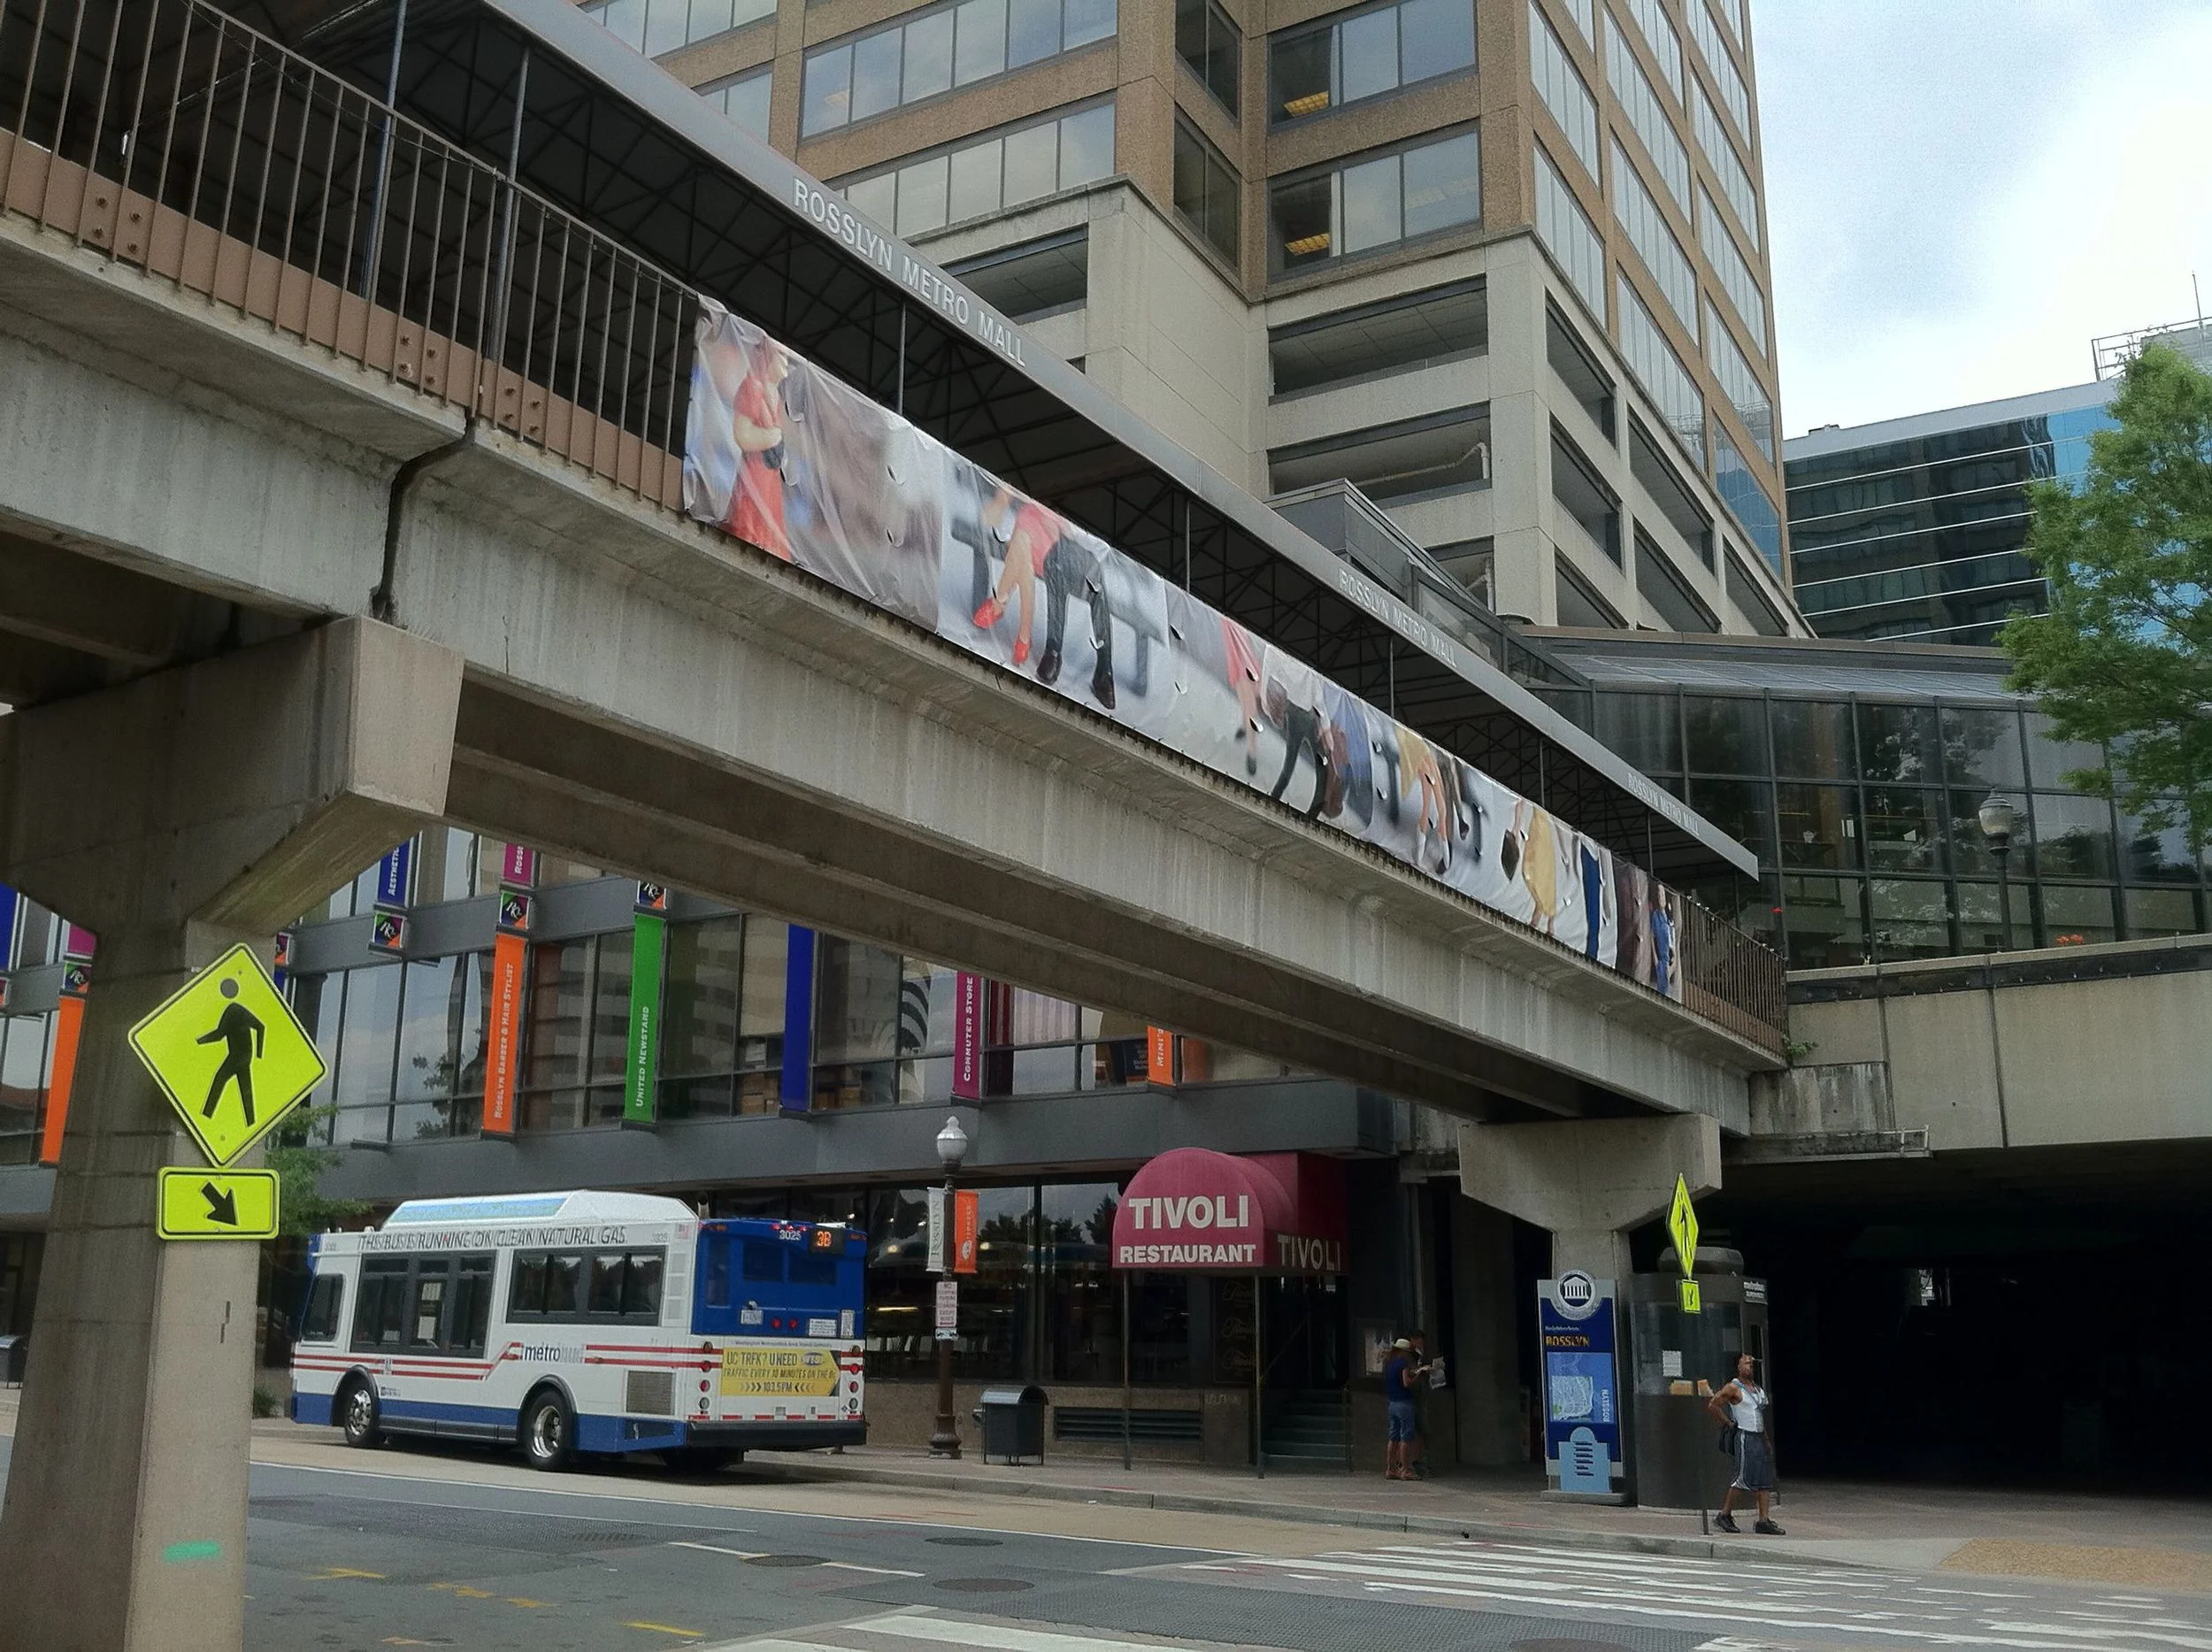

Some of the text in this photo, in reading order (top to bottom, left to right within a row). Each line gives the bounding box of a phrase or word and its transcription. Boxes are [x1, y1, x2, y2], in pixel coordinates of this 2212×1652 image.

[793, 178, 1026, 366] ROSSLYN METRO MALL
[1339, 567, 1457, 667] ROSSLYN METRO MALL
[963, 976, 974, 1082] COMMUTER STORE
[635, 1005, 651, 1107] UNITED NEWSTAND
[930, 1201, 943, 1256] ROSSLYN
[1128, 1195, 1249, 1230] TIVOLI
[360, 1226, 626, 1250] THIS BUS IS RUNNING ON CLEAN NATURAL GAS
[779, 1229, 803, 1241] 3025
[1119, 1244, 1256, 1264] RESTAURANT
[1277, 1234, 1342, 1272] TIVOLI
[1546, 1334, 1590, 1346] ROSSLYN
